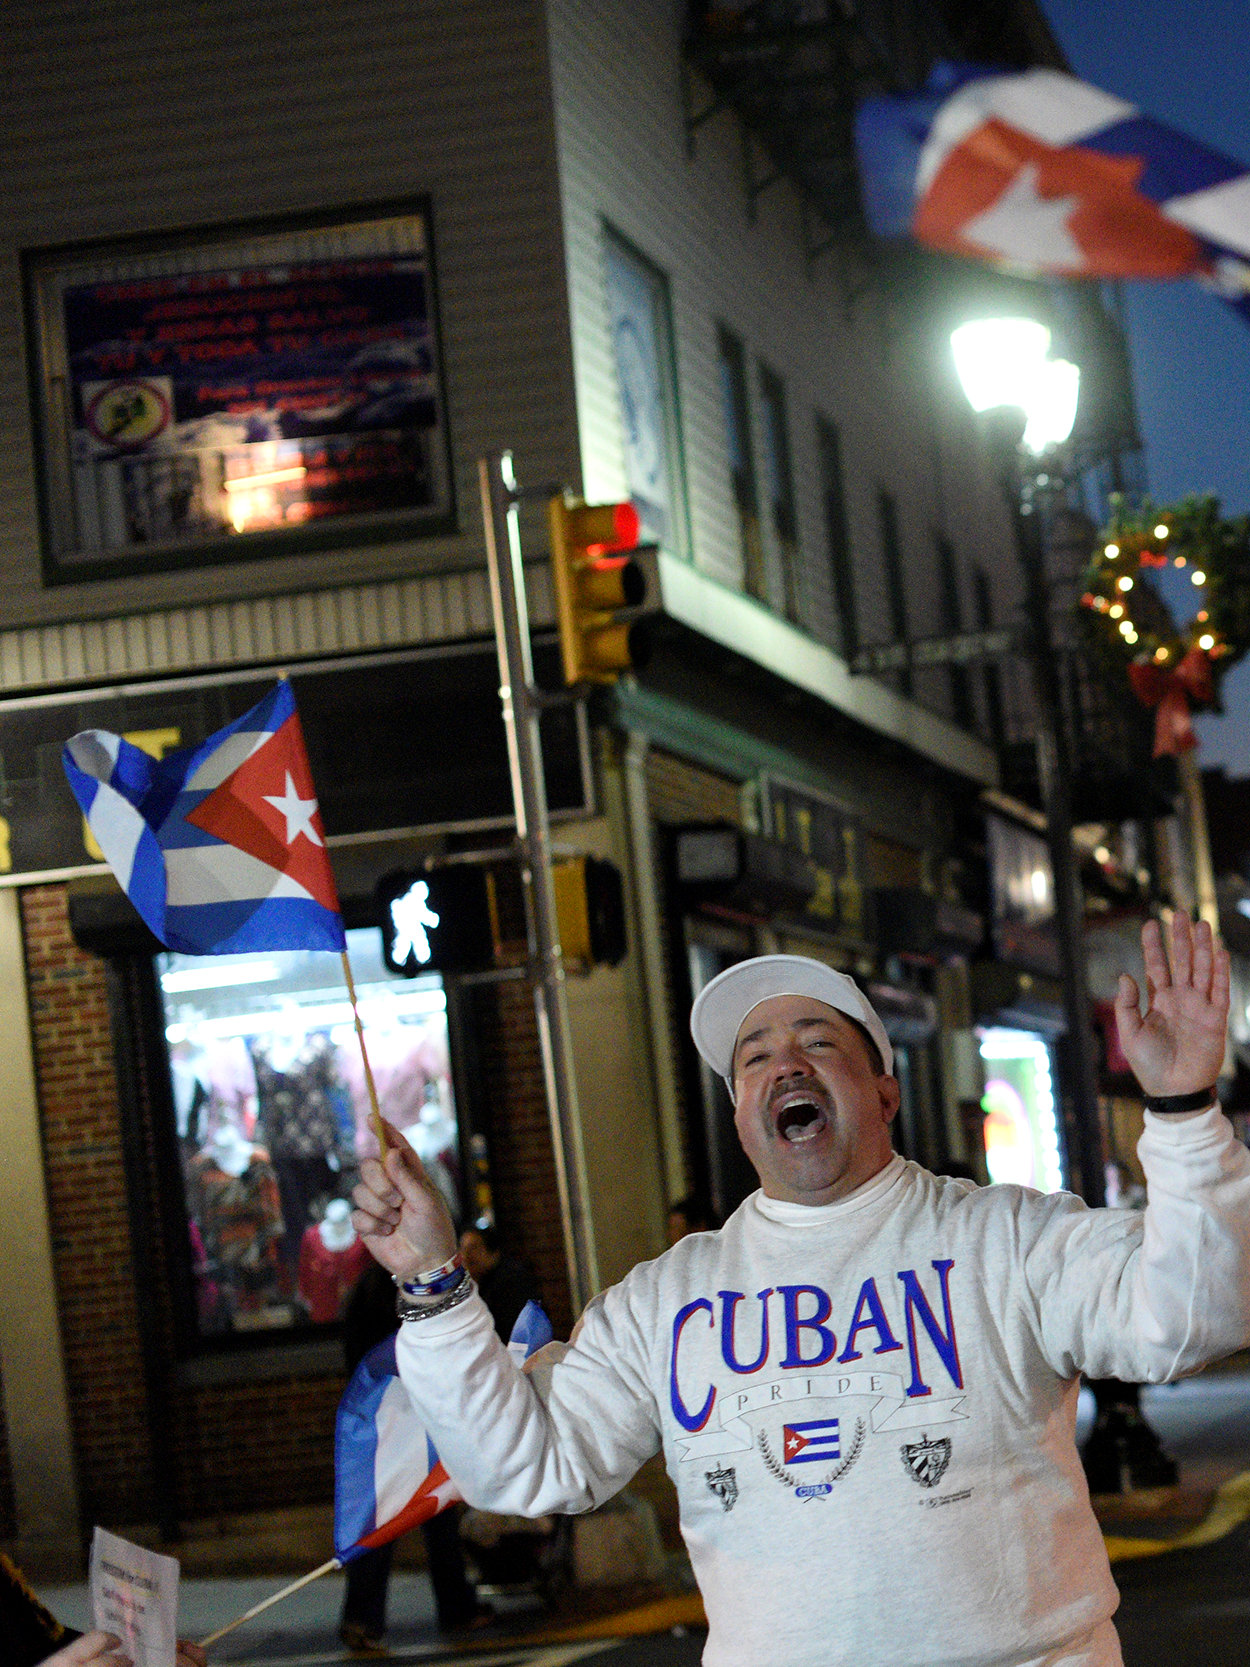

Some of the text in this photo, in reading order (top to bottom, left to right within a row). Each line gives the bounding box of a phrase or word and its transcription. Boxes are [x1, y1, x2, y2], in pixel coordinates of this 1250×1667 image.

[670, 1258, 964, 1433] CUBAN
[737, 1375, 884, 1411] PRIDE
[798, 1484, 831, 1498] CUBA
